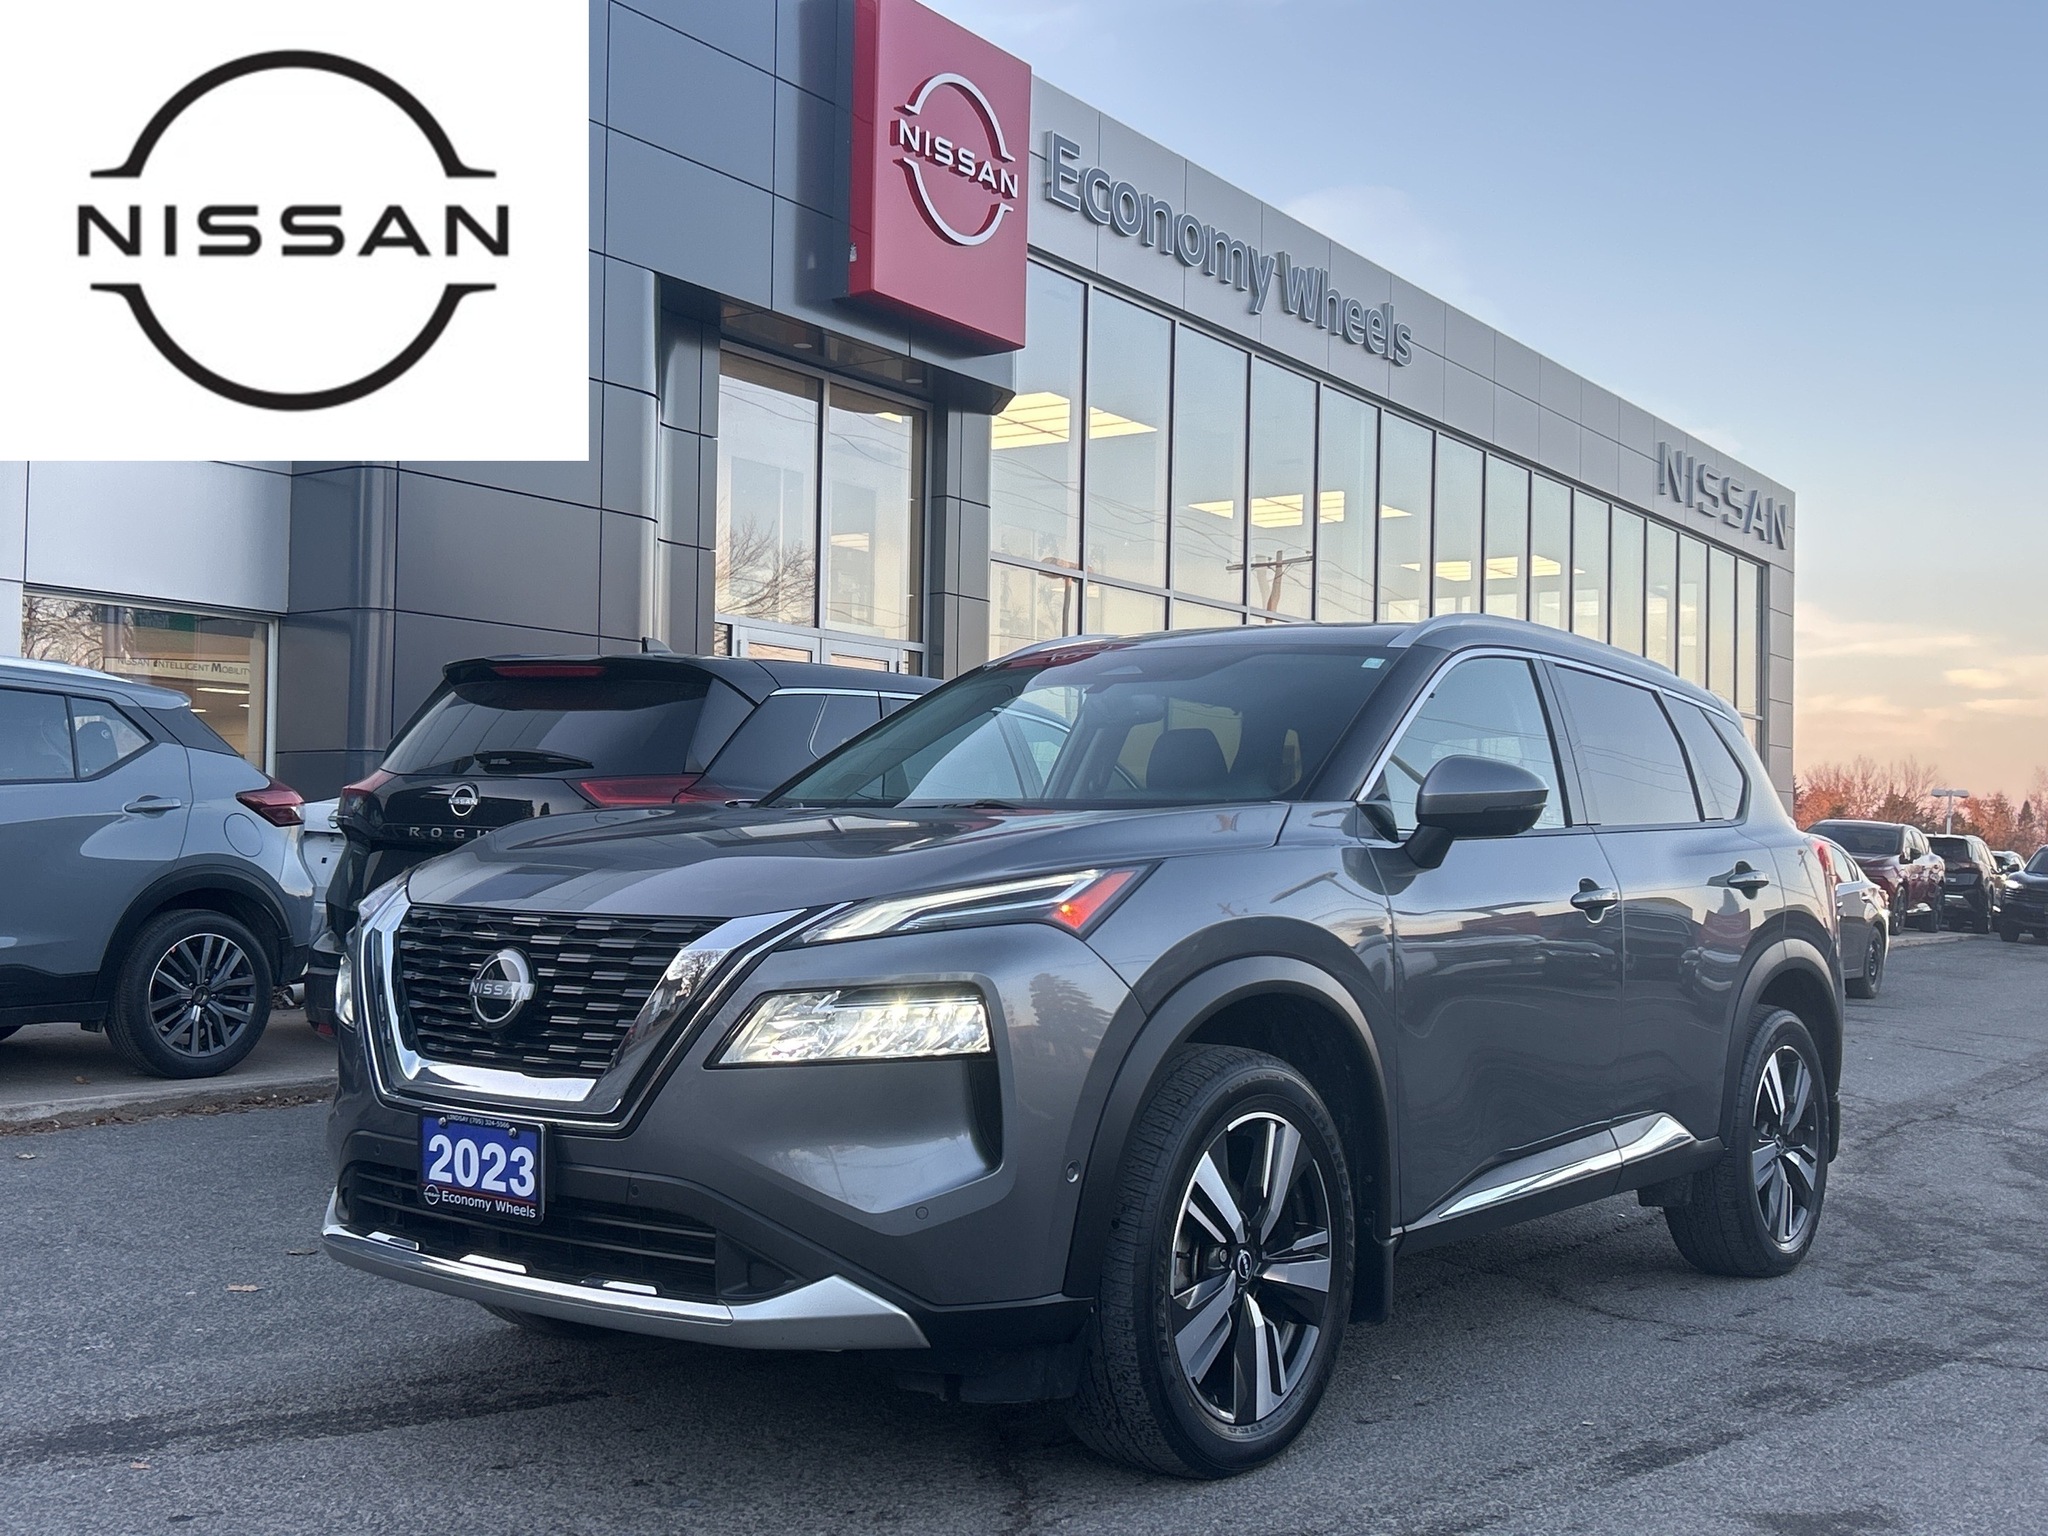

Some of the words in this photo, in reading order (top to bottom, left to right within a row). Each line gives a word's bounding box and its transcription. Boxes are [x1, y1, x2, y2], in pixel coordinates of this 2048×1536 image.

[897, 118, 1018, 198] NISSAN
[1046, 130, 1276, 315] Economy
[1278, 251, 1412, 367] Wheels
[1658, 441, 1788, 551] NISSAN
[470, 981, 531, 998] NISSAN
[428, 1134, 536, 1197] 2023
[441, 1190, 492, 1212] Economy
[495, 1200, 536, 1218] Wheels
